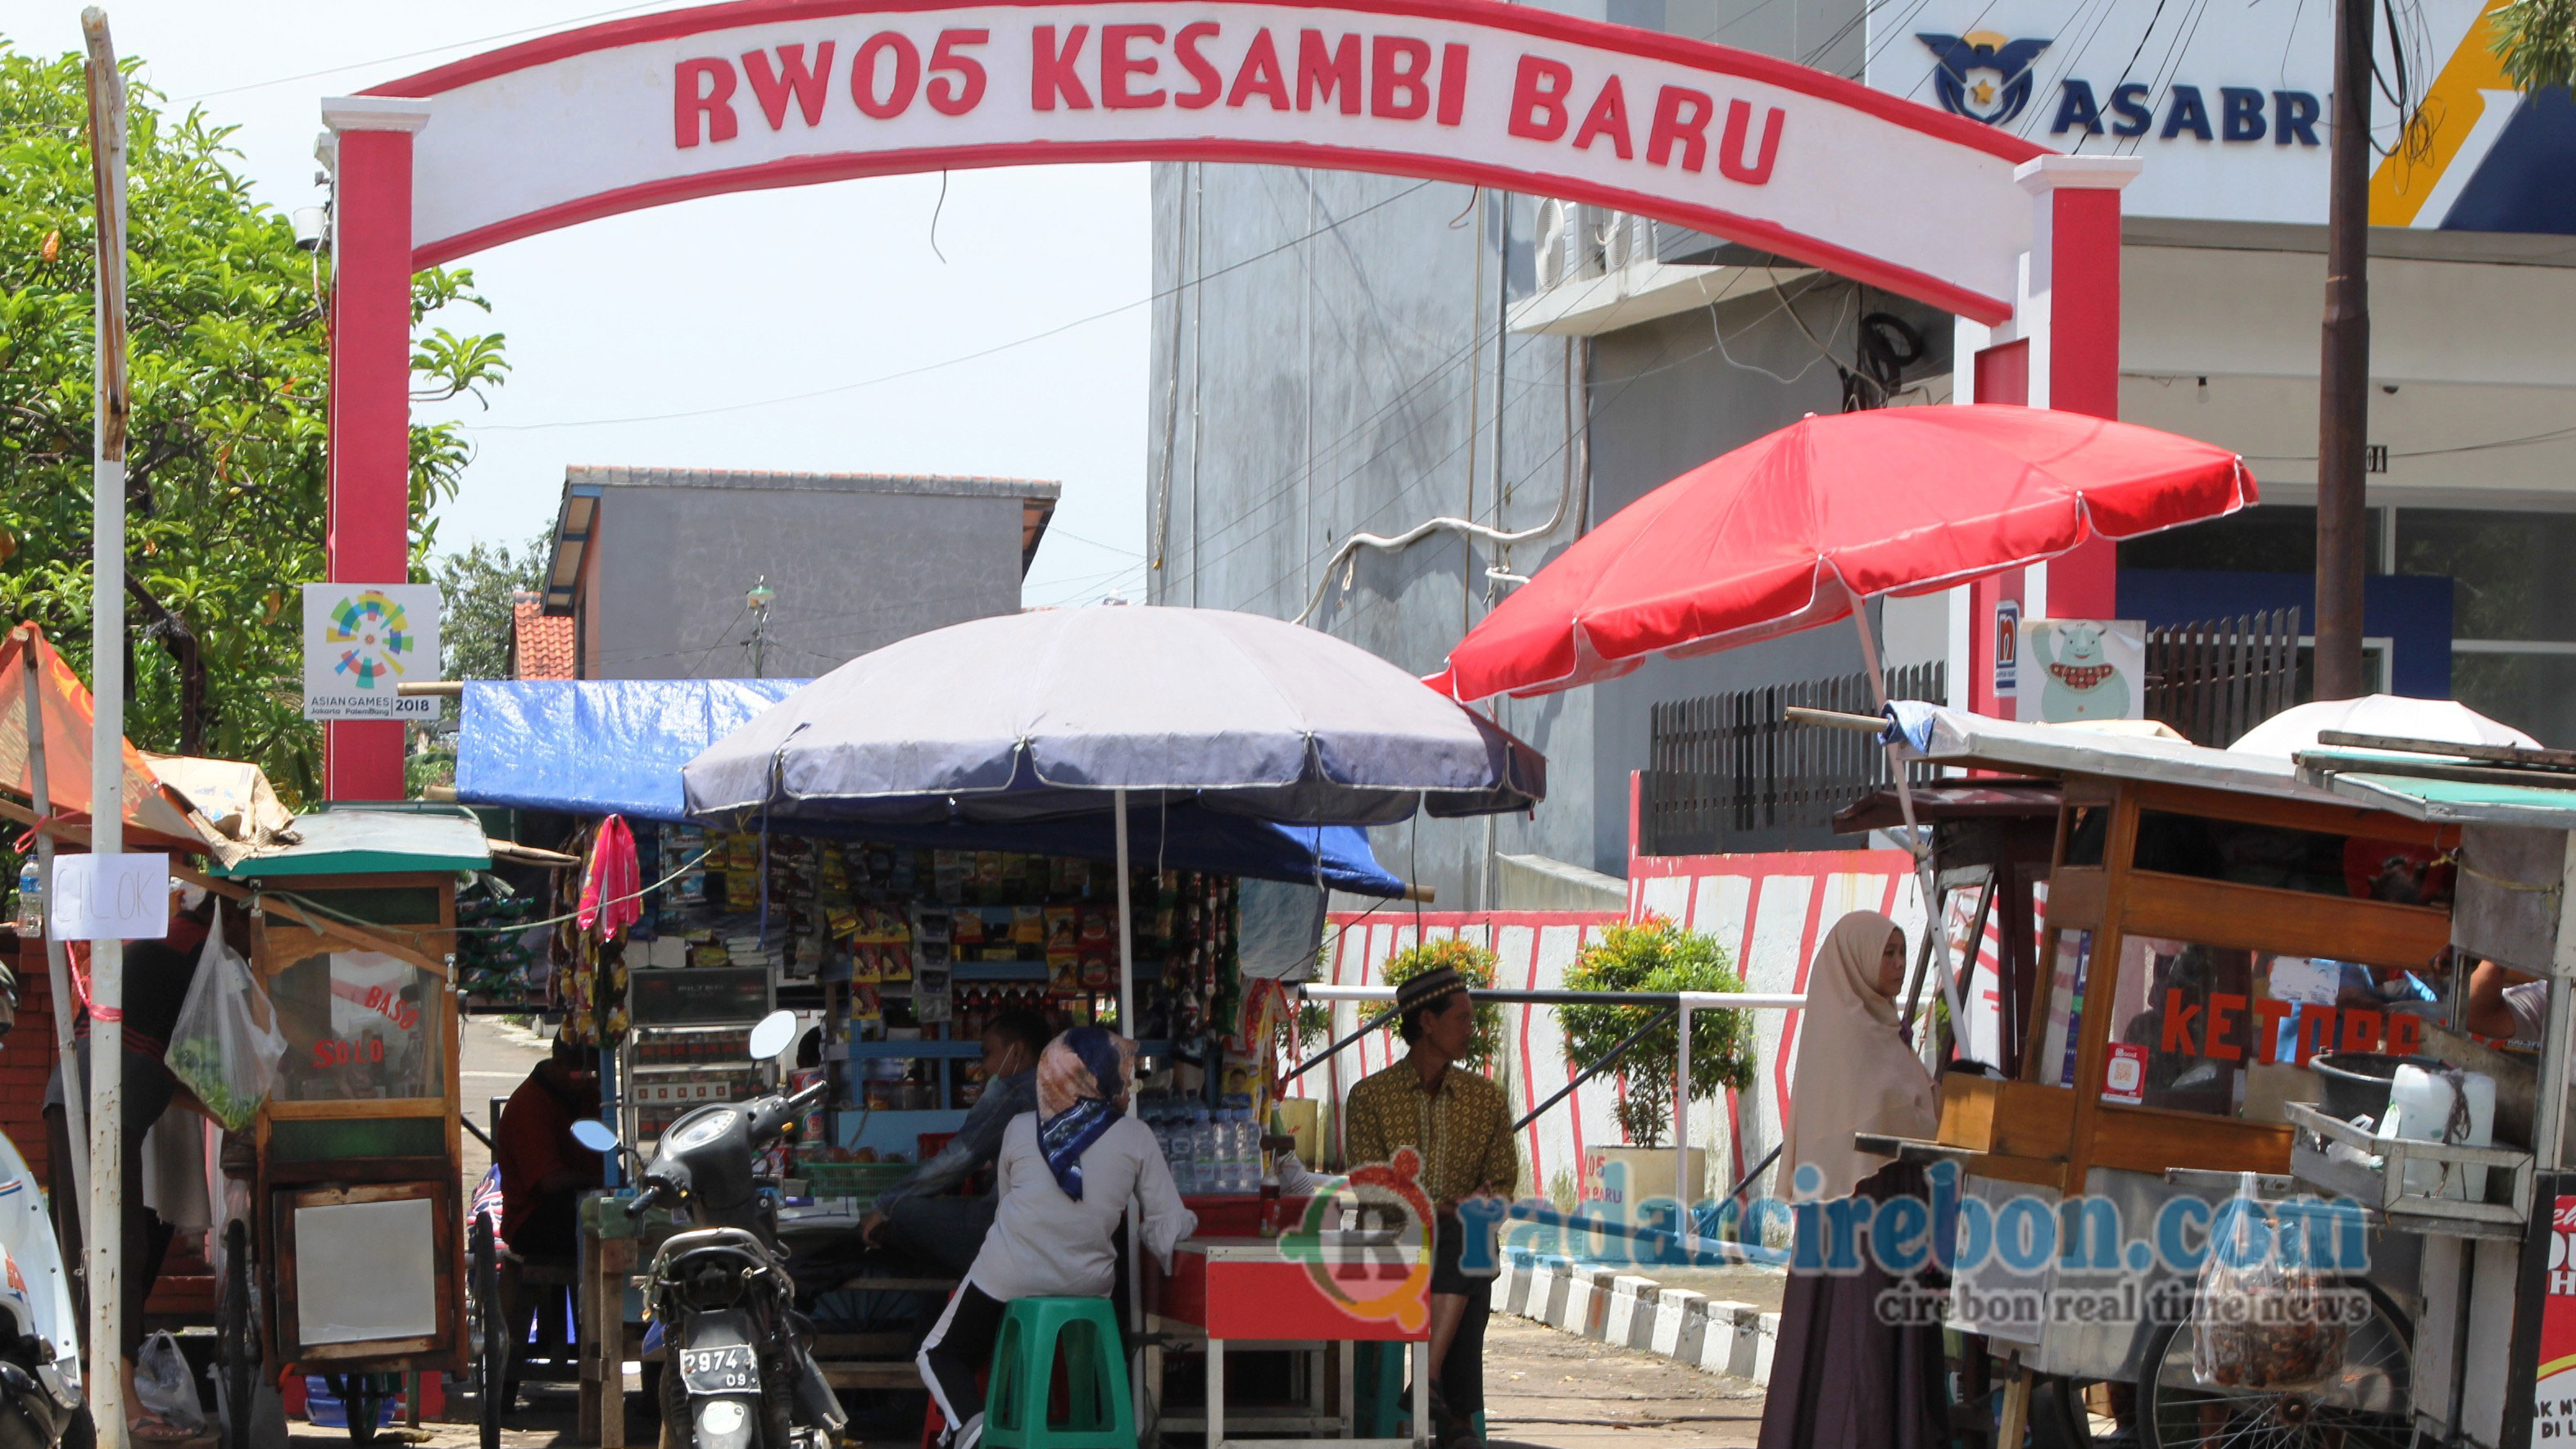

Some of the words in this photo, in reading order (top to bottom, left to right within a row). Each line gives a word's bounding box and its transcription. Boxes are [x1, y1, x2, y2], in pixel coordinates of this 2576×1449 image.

[1030, 21, 1470, 127] KESAMBI
[1507, 53, 1786, 185] BARU
[2051, 78, 2333, 146] ASABR
[311, 696, 346, 707] ASIAN
[348, 696, 390, 707] GAMES
[395, 699, 429, 712] 2018
[311, 707, 341, 715] Jakarta
[364, 985, 420, 1030] BASO
[2160, 988, 2507, 1069] KETOPR
[312, 1039, 383, 1069] SOLO
[1592, 1186, 1623, 1204] BARU
[684, 1349, 738, 1374] 2974
[726, 1373, 746, 1388] 09
[2542, 1420, 2560, 1439] DI
